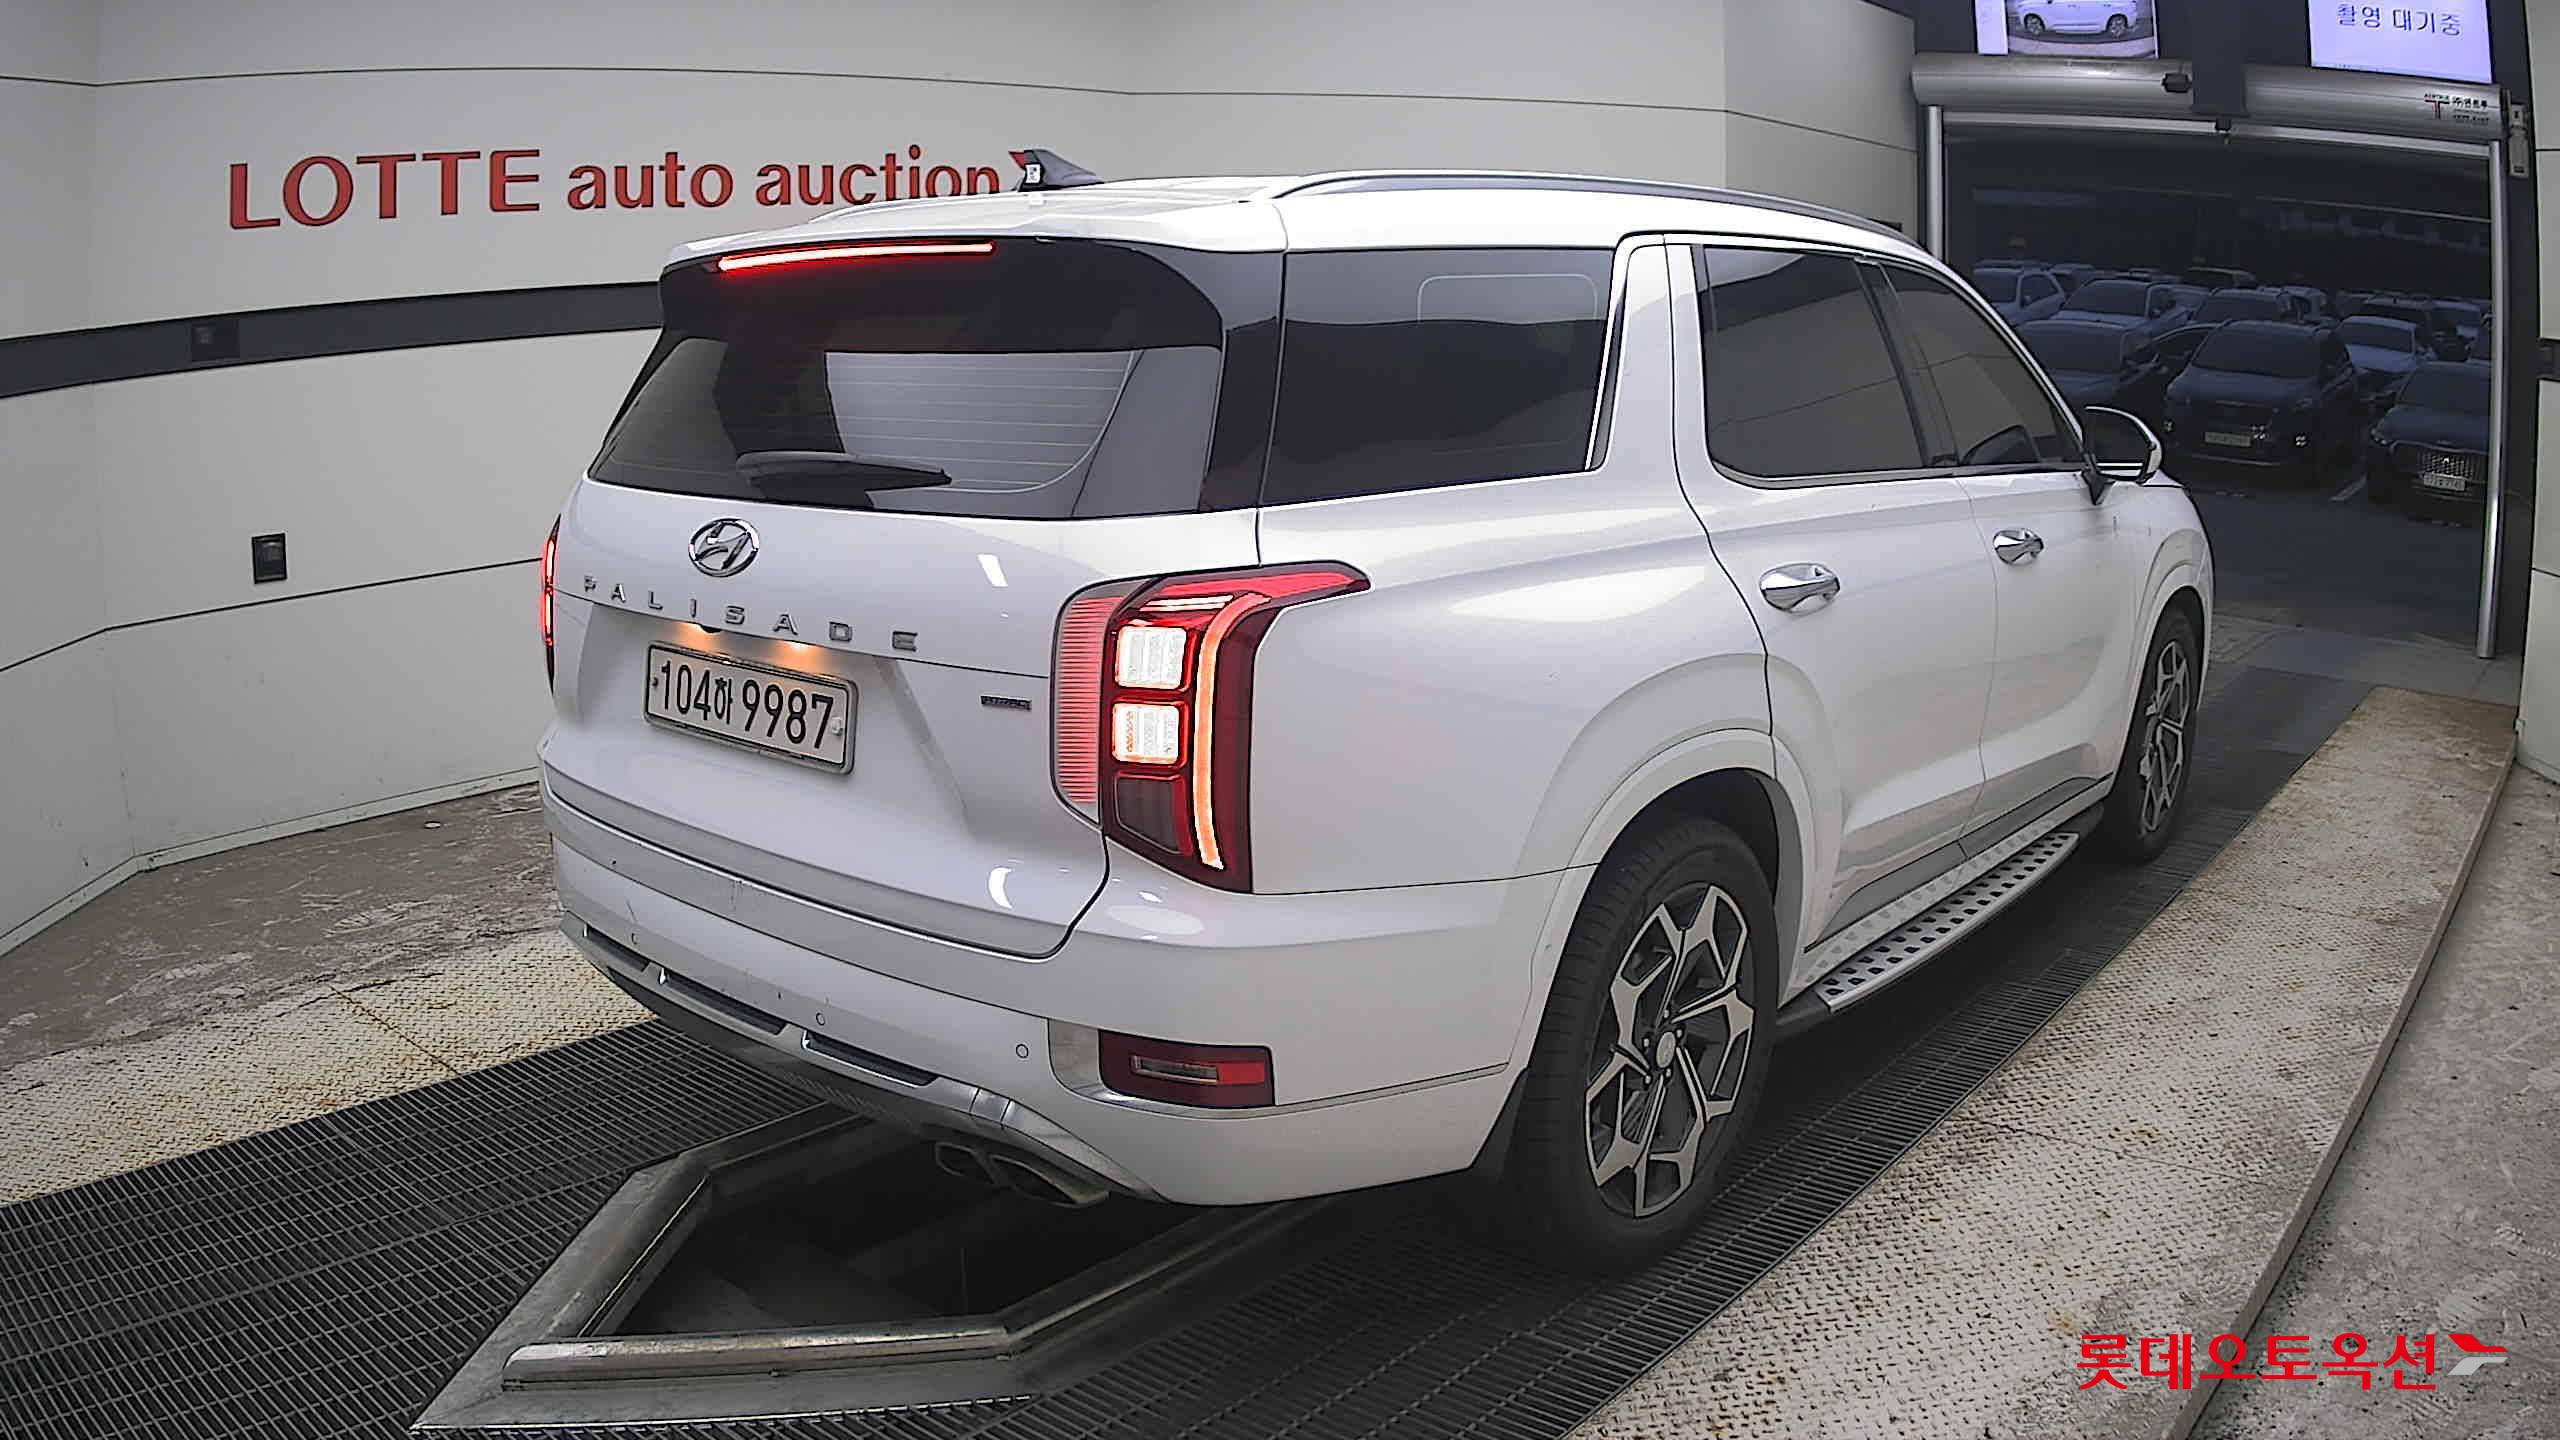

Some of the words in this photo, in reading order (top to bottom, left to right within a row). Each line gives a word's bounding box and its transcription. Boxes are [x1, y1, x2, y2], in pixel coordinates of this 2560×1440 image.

[2337, 4, 2381, 29] 촬영
[2392, 8, 2461, 36] 대기중
[229, 149, 541, 229] LOTTE
[566, 150, 736, 209] auto
[755, 144, 1001, 206] auction
[584, 576, 918, 652] PALISADE
[742, 679, 834, 749] 9987
